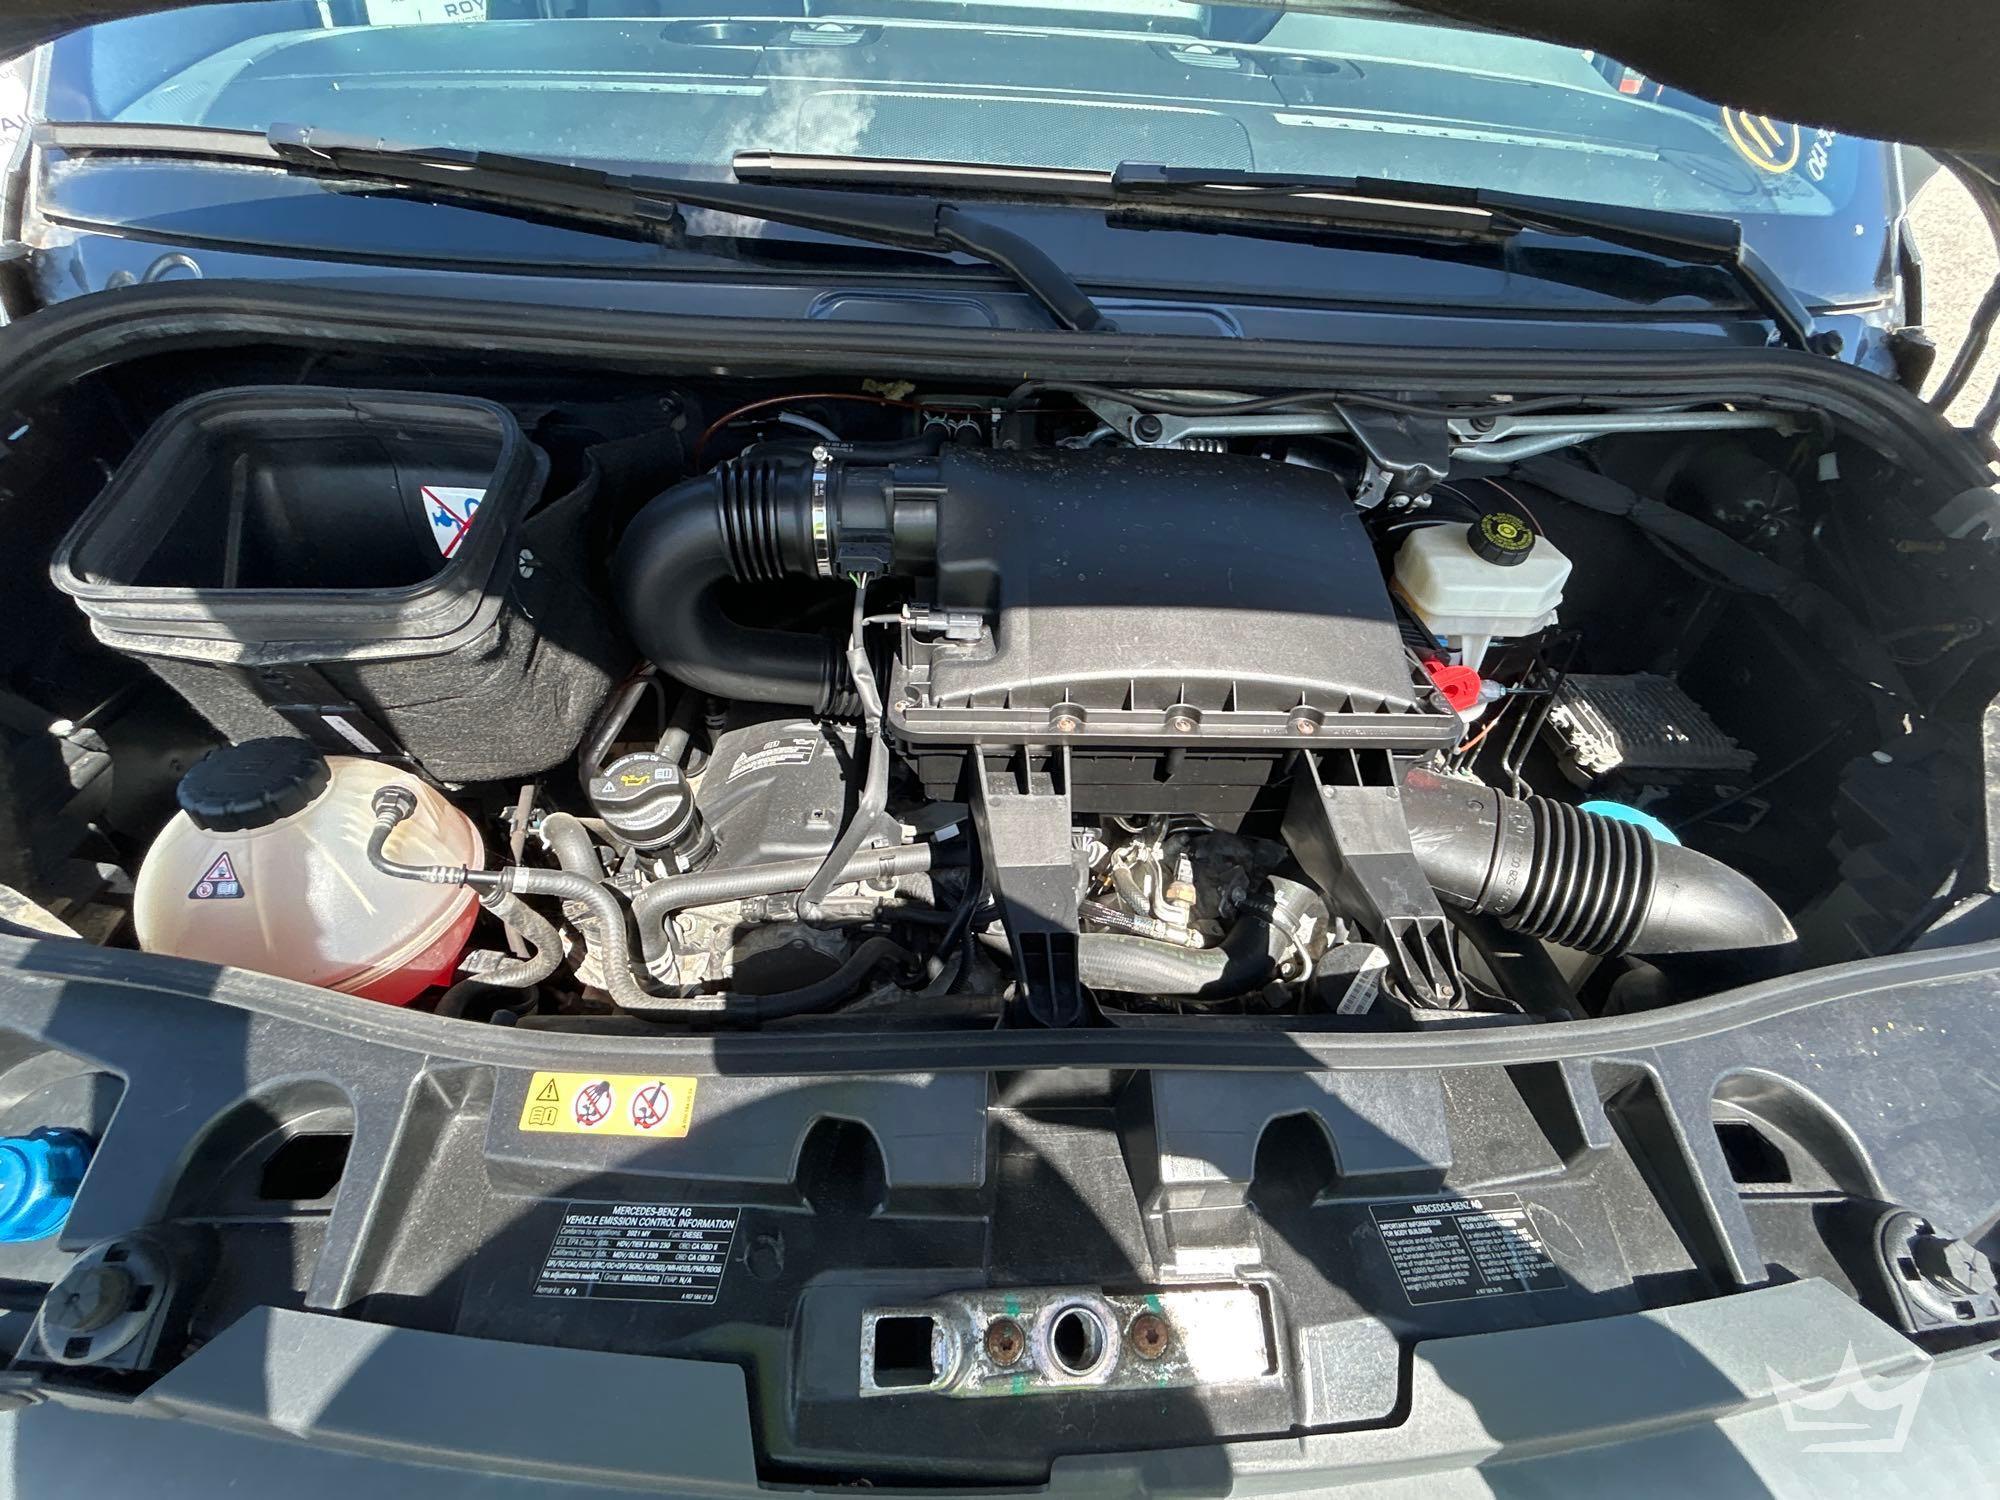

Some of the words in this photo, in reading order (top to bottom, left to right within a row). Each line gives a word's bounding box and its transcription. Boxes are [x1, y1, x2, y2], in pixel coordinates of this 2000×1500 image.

[612, 1205, 679, 1216] MERCEDES-BENZ
[678, 1207, 692, 1217] AG
[1412, 1200, 1471, 1214] MERCEDES-BENZ
[565, 1215, 599, 1225] VEHICLE
[598, 1216, 638, 1226] EMISSION
[638, 1217, 676, 1227] CONTROL
[677, 1218, 735, 1228] INFORMATION
[681, 1231, 703, 1239] DIESEL
[691, 1242, 700, 1250] CA
[687, 1253, 696, 1261] CA
[678, 1276, 692, 1285] N/A
